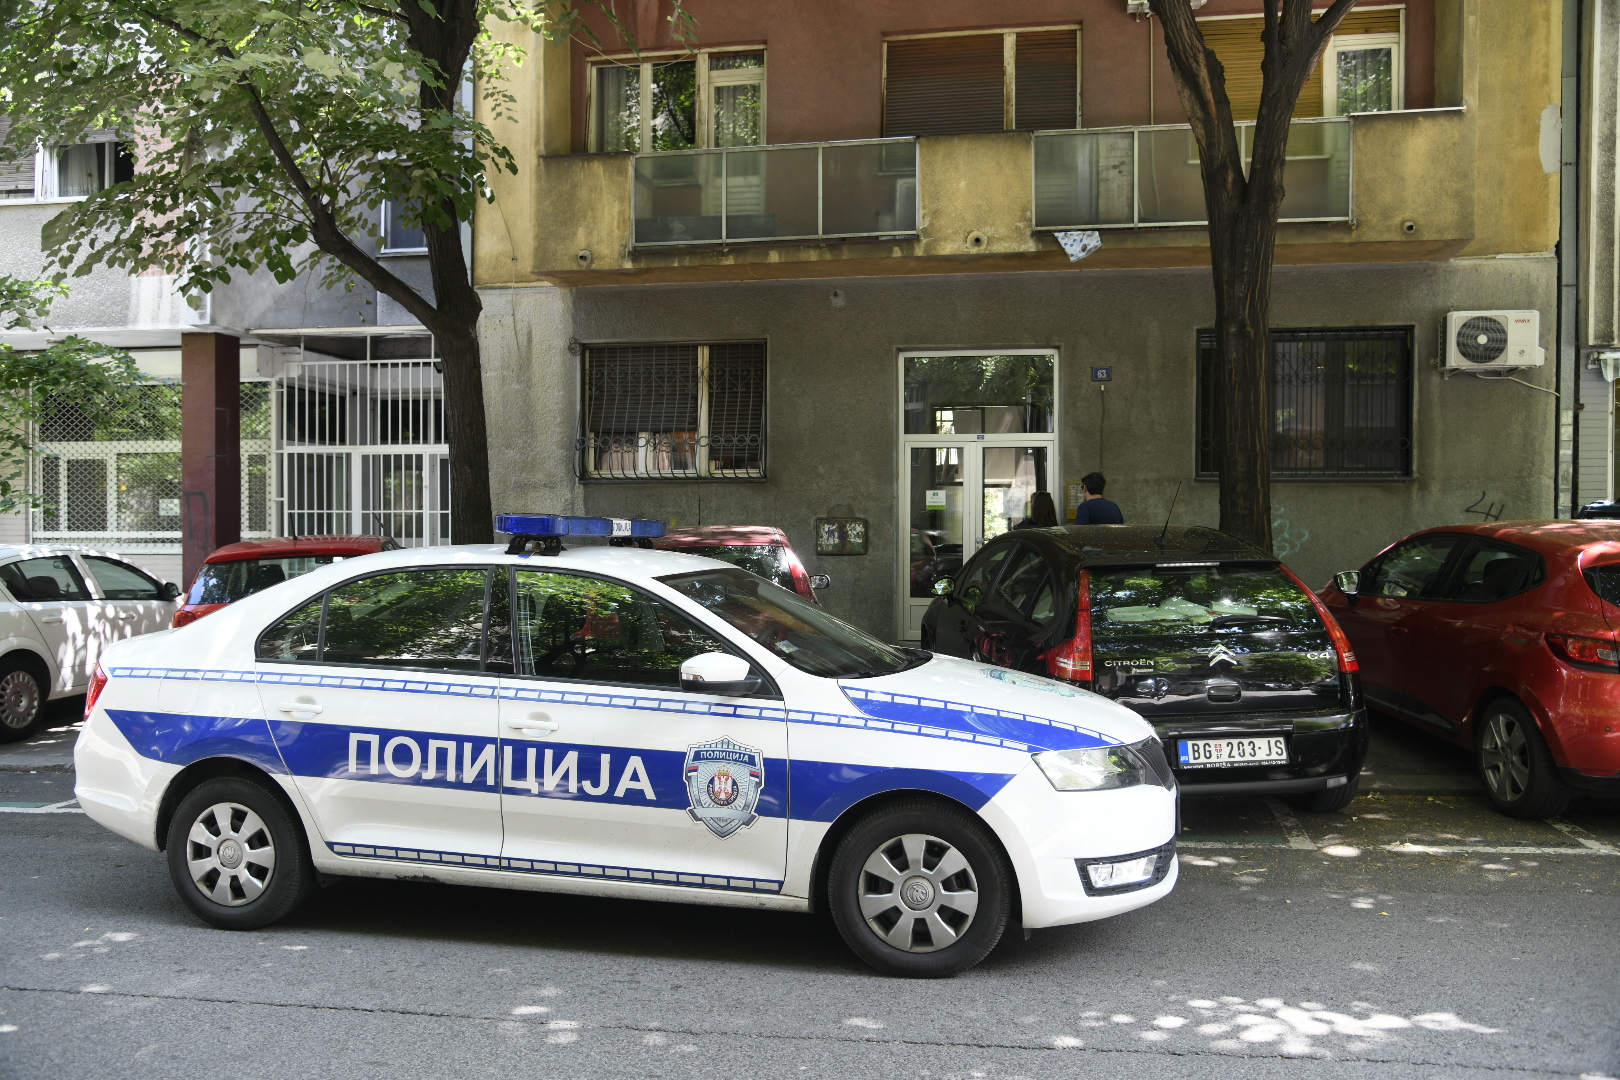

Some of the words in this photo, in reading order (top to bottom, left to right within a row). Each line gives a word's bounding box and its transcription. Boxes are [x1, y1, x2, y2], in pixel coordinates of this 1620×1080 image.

[1097, 369, 1107, 379] 63
[1306, 651, 1331, 660] C4
[1103, 658, 1155, 667] CITROËN
[700, 751, 749, 763] ПОЛИЦИЈА
[1191, 742, 1213, 761] BG
[347, 731, 657, 801] ПОЛИЦИЈА
